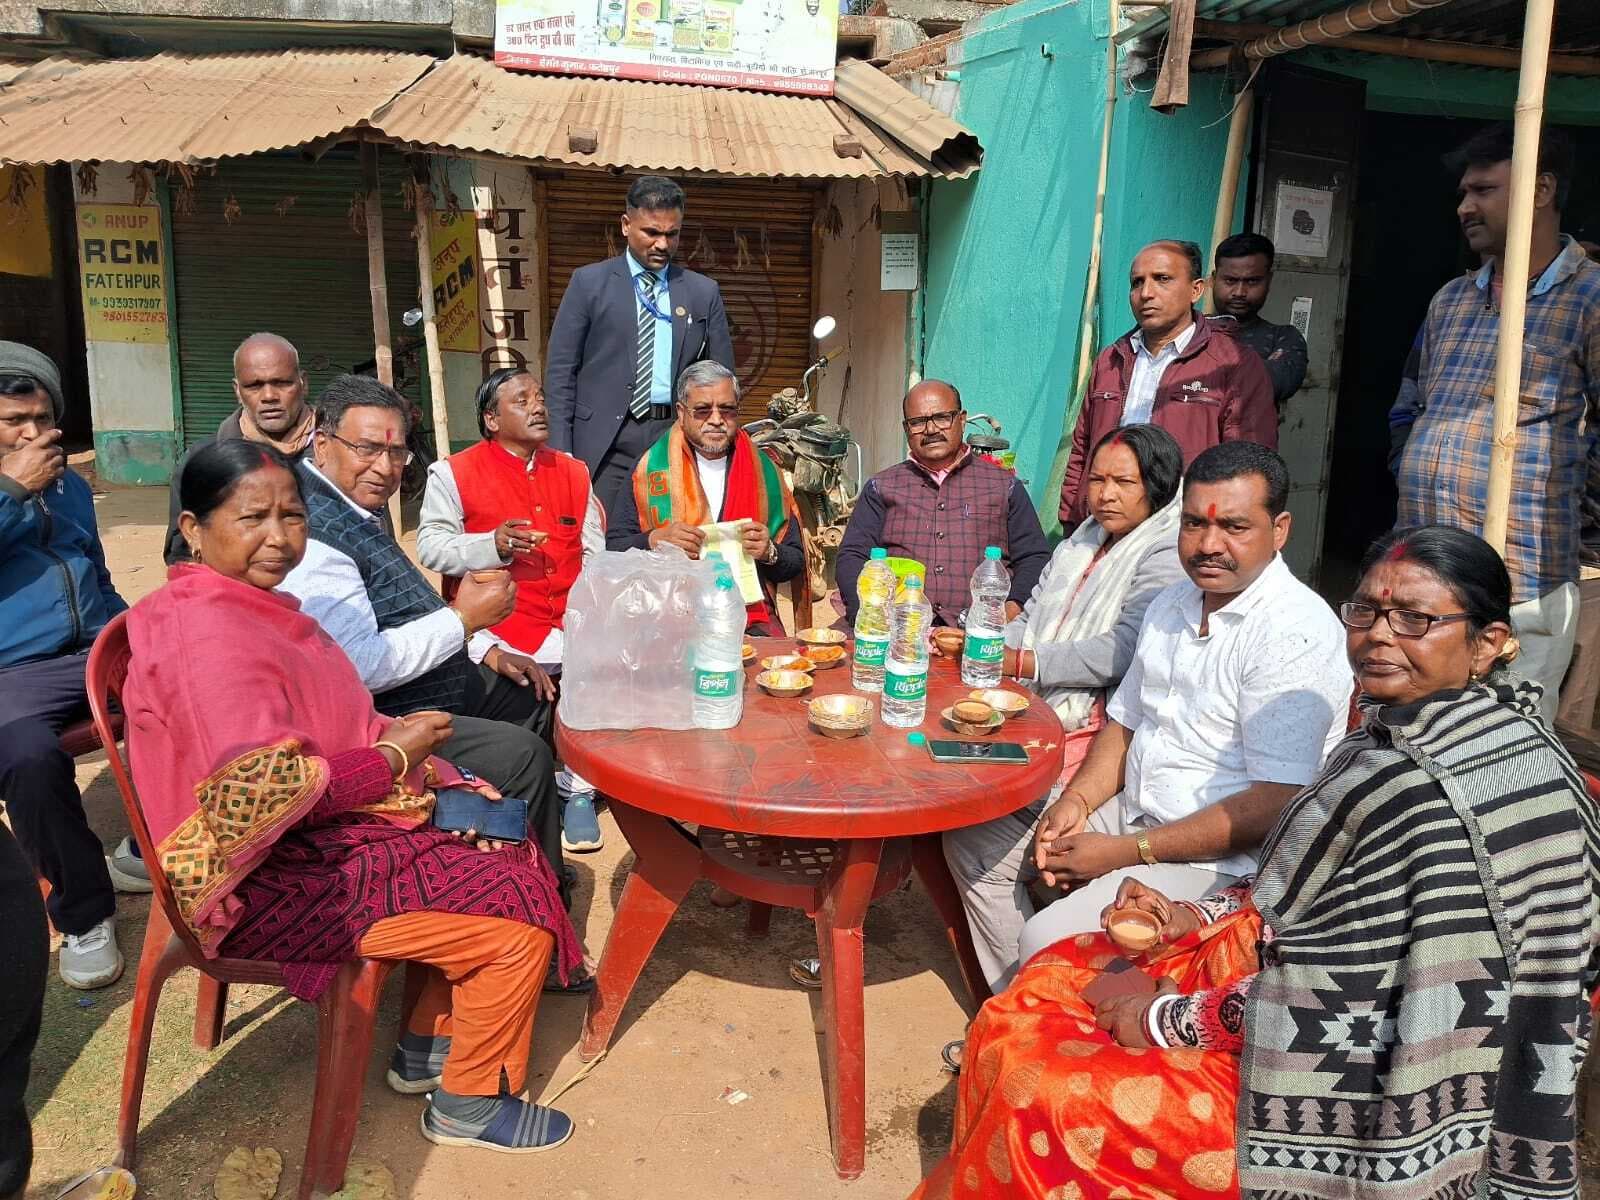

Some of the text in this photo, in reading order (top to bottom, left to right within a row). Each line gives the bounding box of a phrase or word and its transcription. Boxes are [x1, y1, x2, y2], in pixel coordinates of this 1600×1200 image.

[524, 33, 538, 46] दिन
[105, 215, 149, 229] ANUP
[84, 238, 160, 265] RCM
[85, 272, 161, 289] FATEHPUR
[433, 255, 474, 308] RCM
